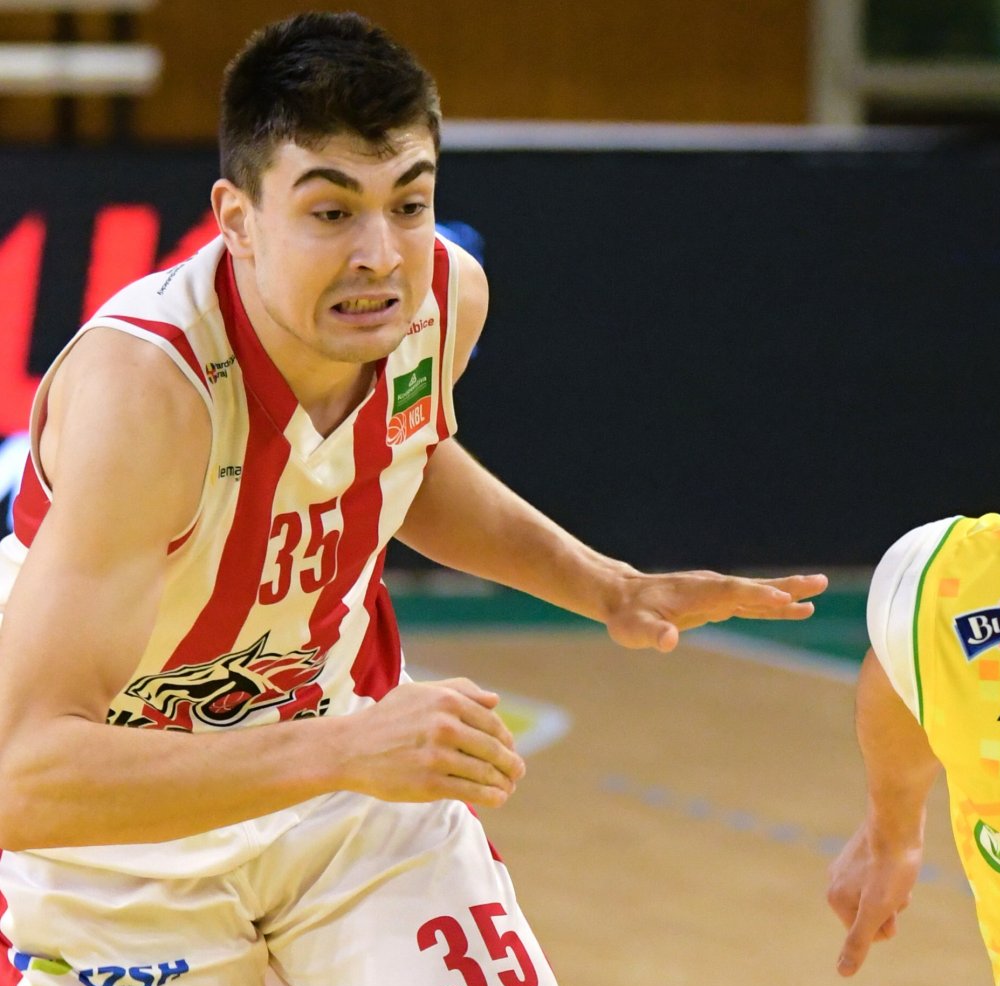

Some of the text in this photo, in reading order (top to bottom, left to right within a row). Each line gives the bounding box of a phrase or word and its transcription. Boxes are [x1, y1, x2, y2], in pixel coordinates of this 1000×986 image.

[408, 404, 426, 430] NBL
[218, 465, 242, 479] lema
[258, 496, 344, 606] 35
